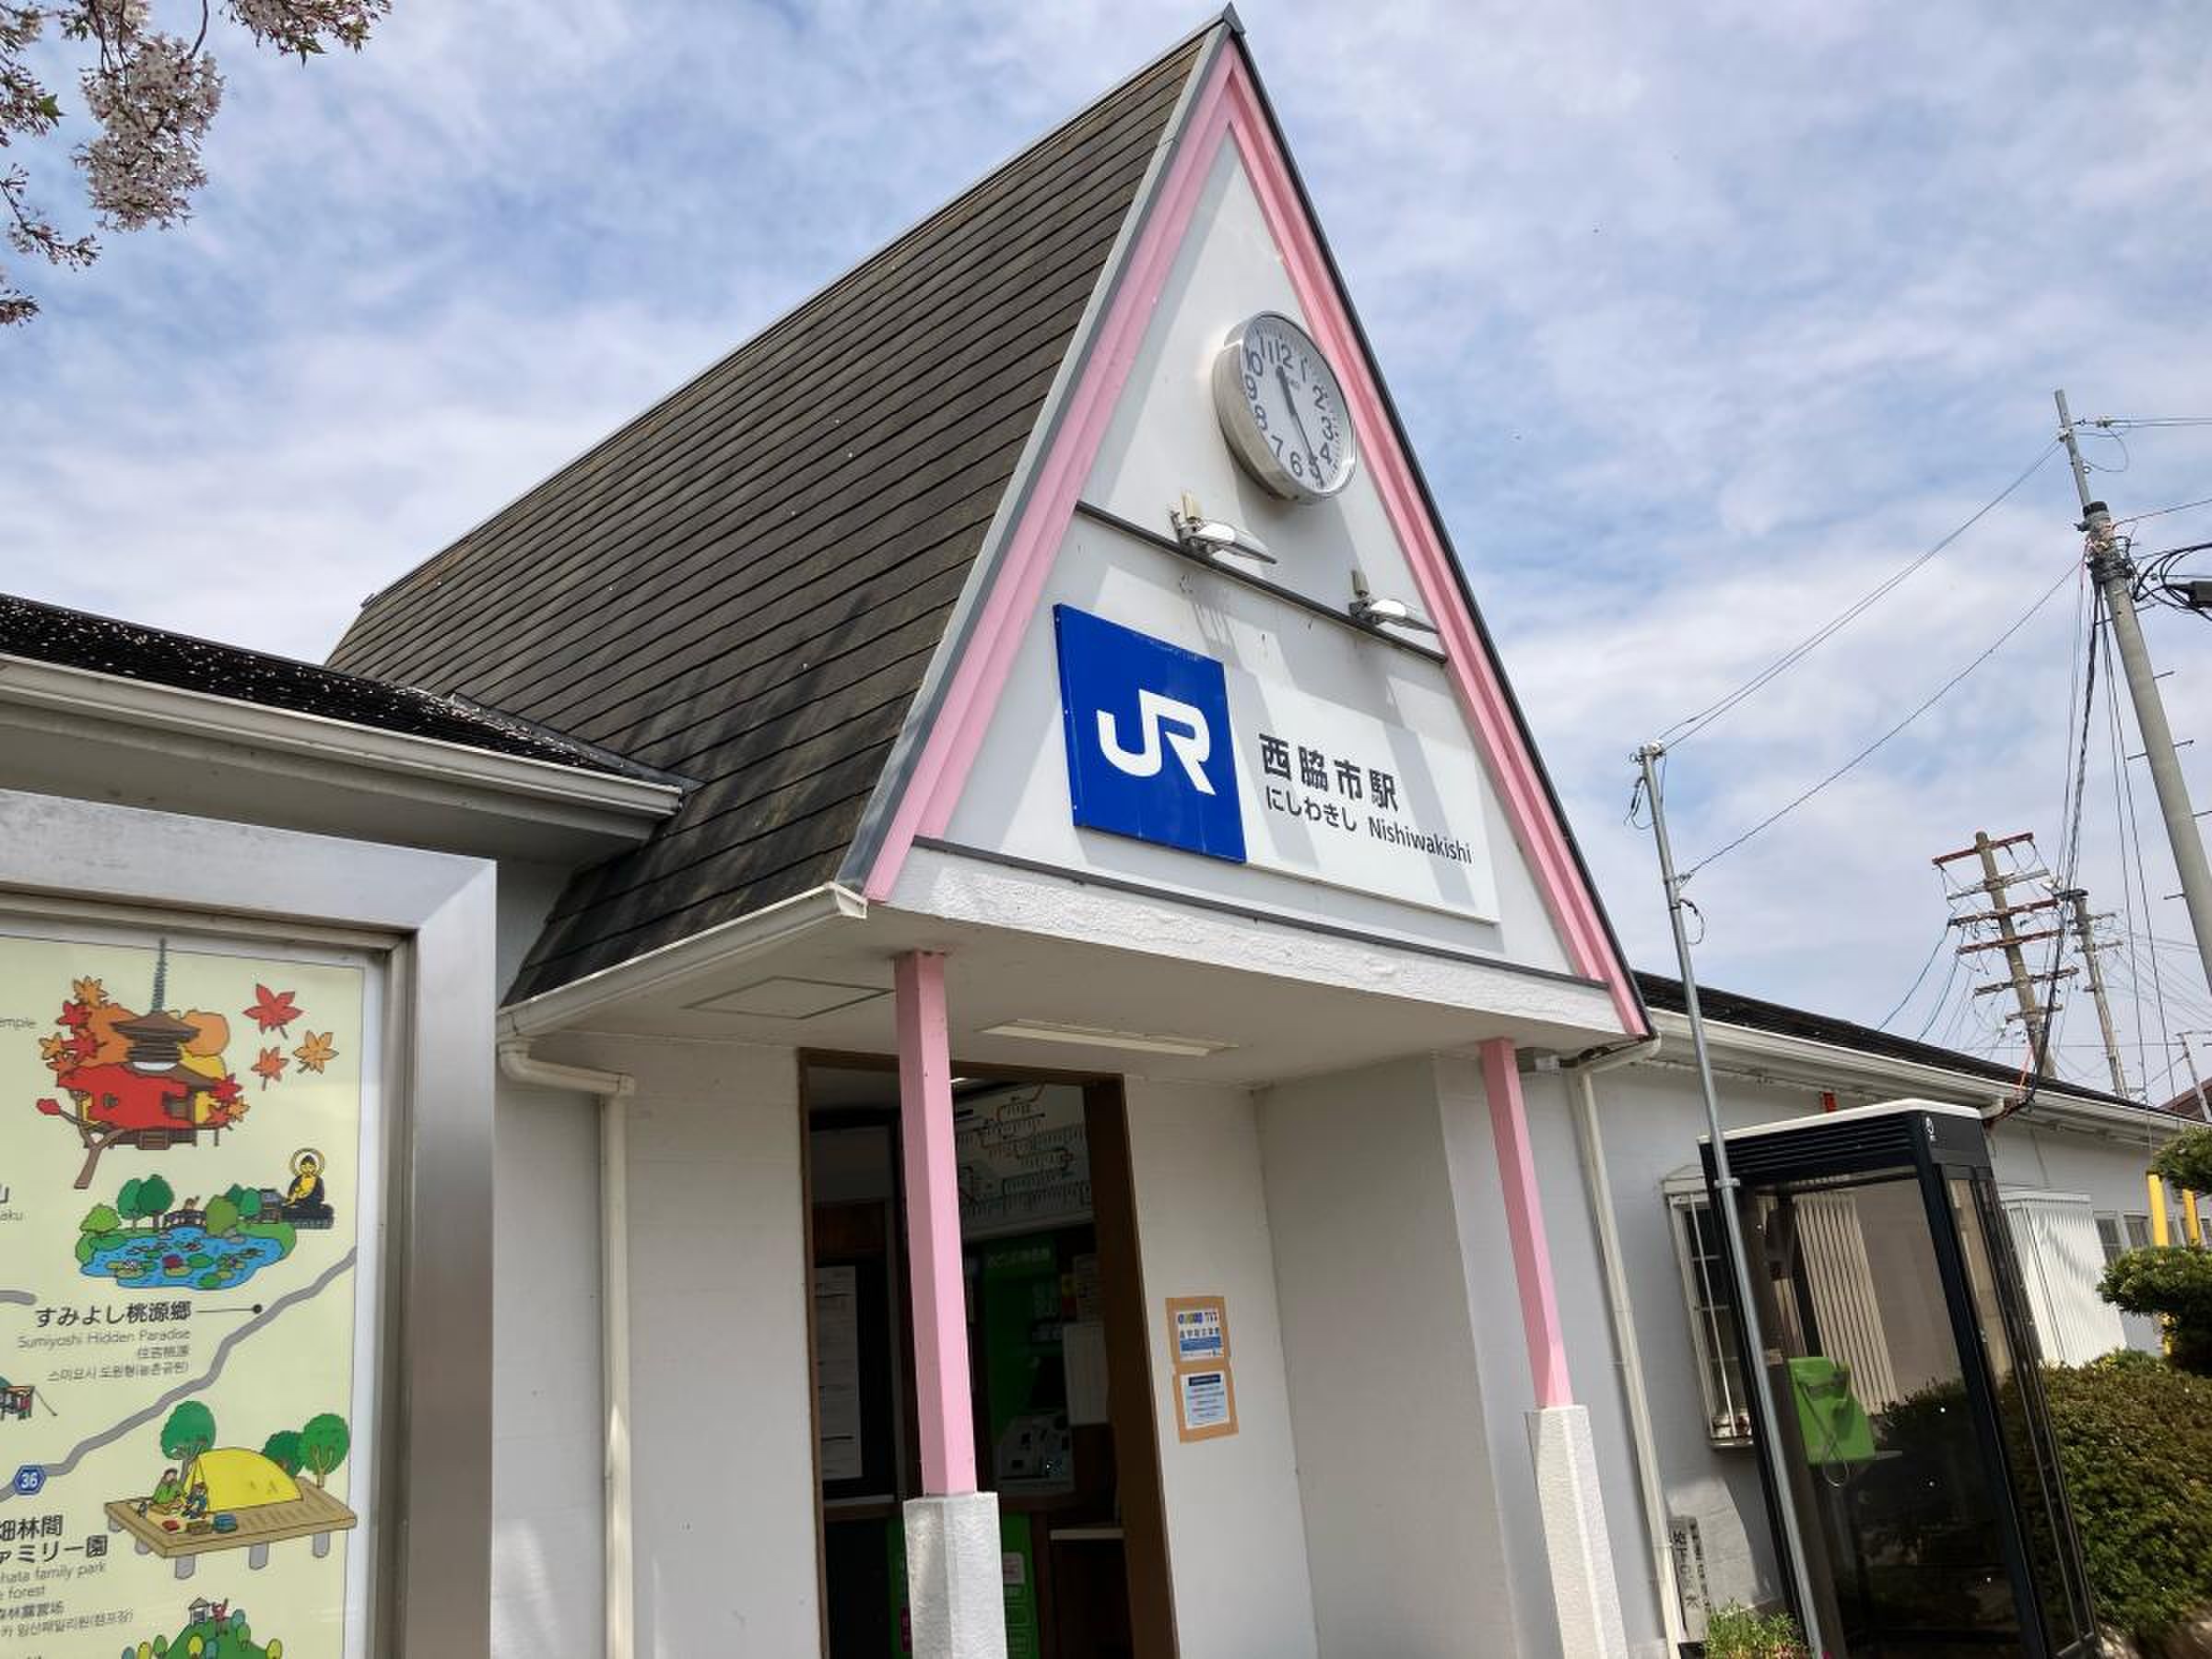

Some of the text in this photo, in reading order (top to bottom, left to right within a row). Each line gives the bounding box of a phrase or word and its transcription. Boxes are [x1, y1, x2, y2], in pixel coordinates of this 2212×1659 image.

[1245, 347, 1265, 377] 10
[1259, 335, 1275, 365] 11
[1275, 338, 1294, 370] 12
[1300, 356, 1309, 382] 1
[1244, 373, 1258, 401] 9
[1312, 384, 1328, 411] 2
[1254, 404, 1268, 431] 8
[1321, 415, 1334, 441] 3
[1270, 434, 1284, 458] 7
[1319, 441, 1333, 465] 4
[1290, 451, 1304, 477] 6
[1096, 688, 1216, 795] JR
[1258, 733, 1398, 812] 西脇市駅
[1266, 785, 1473, 865] にしわきし Nishiwakishi
[34, 1300, 192, 1327] すみよし桃源郷
[18, 1328, 191, 1351] Sumiyoshi Hidden Paradise
[21, 1472, 38, 1488] 36
[35, 1564, 75, 1581] family
[77, 1561, 106, 1578] park
[8, 1585, 45, 1599] forest
